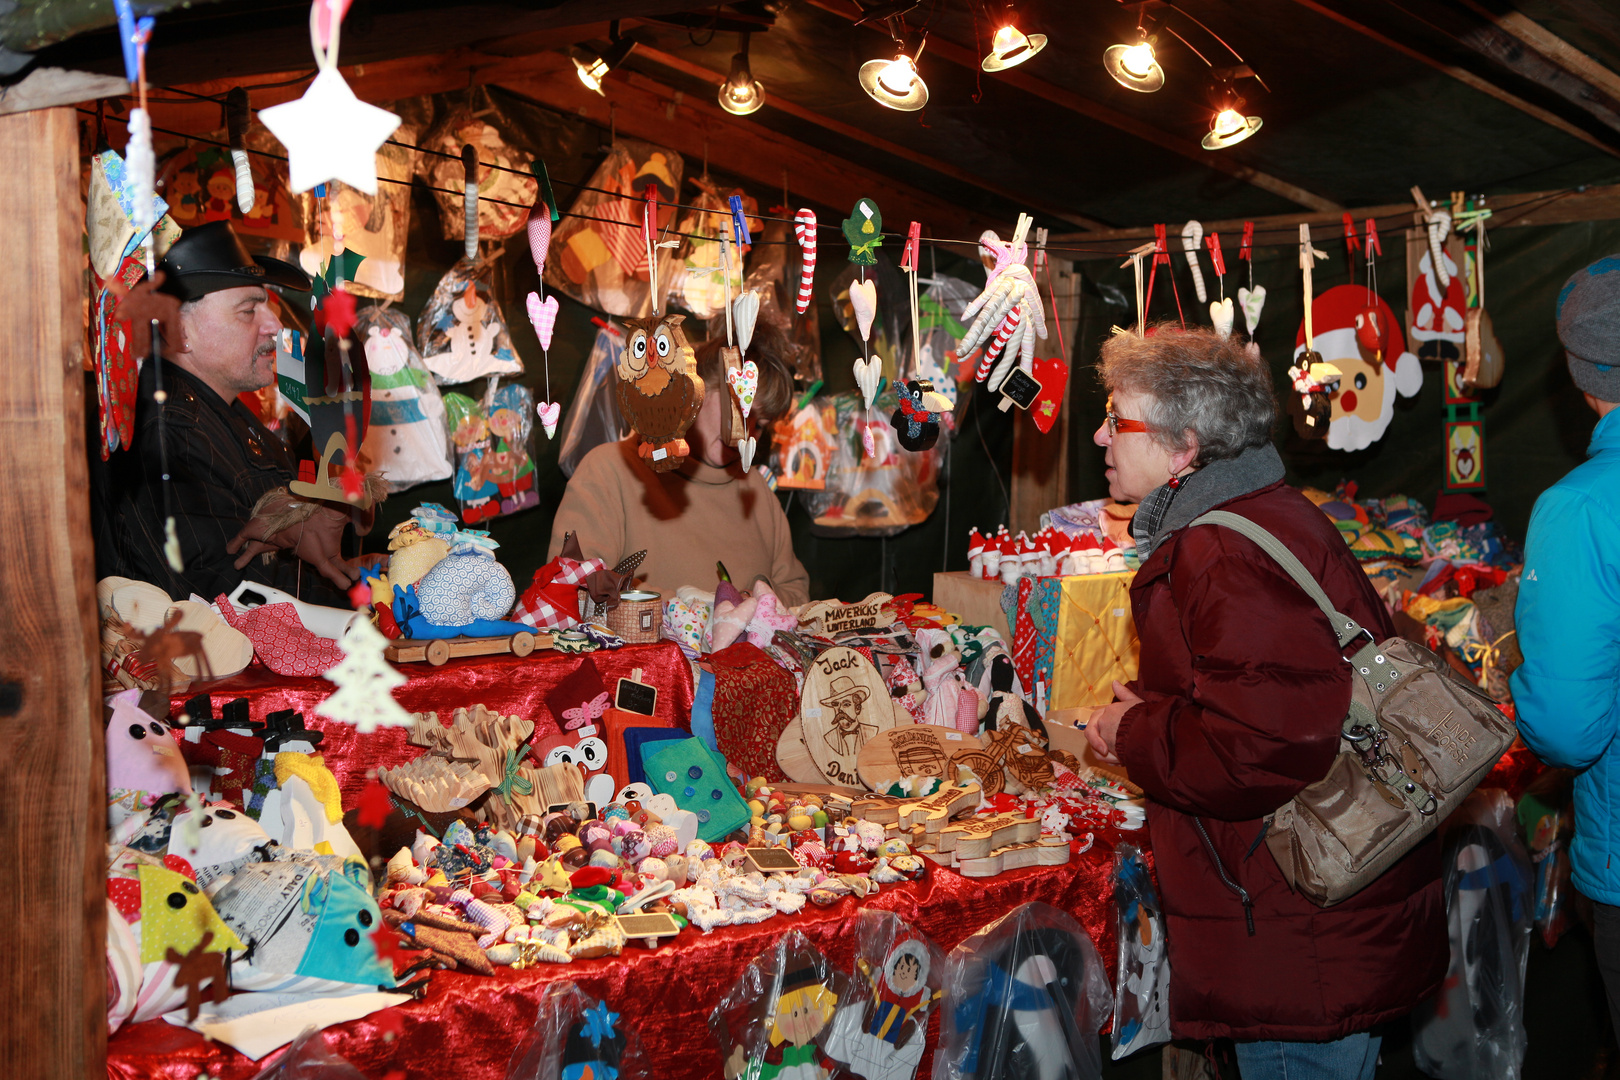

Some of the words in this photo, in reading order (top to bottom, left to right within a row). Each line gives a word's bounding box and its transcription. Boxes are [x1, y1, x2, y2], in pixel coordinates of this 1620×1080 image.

[825, 603, 879, 623] MAVERICKS
[815, 650, 860, 676] Jack
[1441, 715, 1477, 750] LINDE
[280, 873, 304, 900] DAILY
